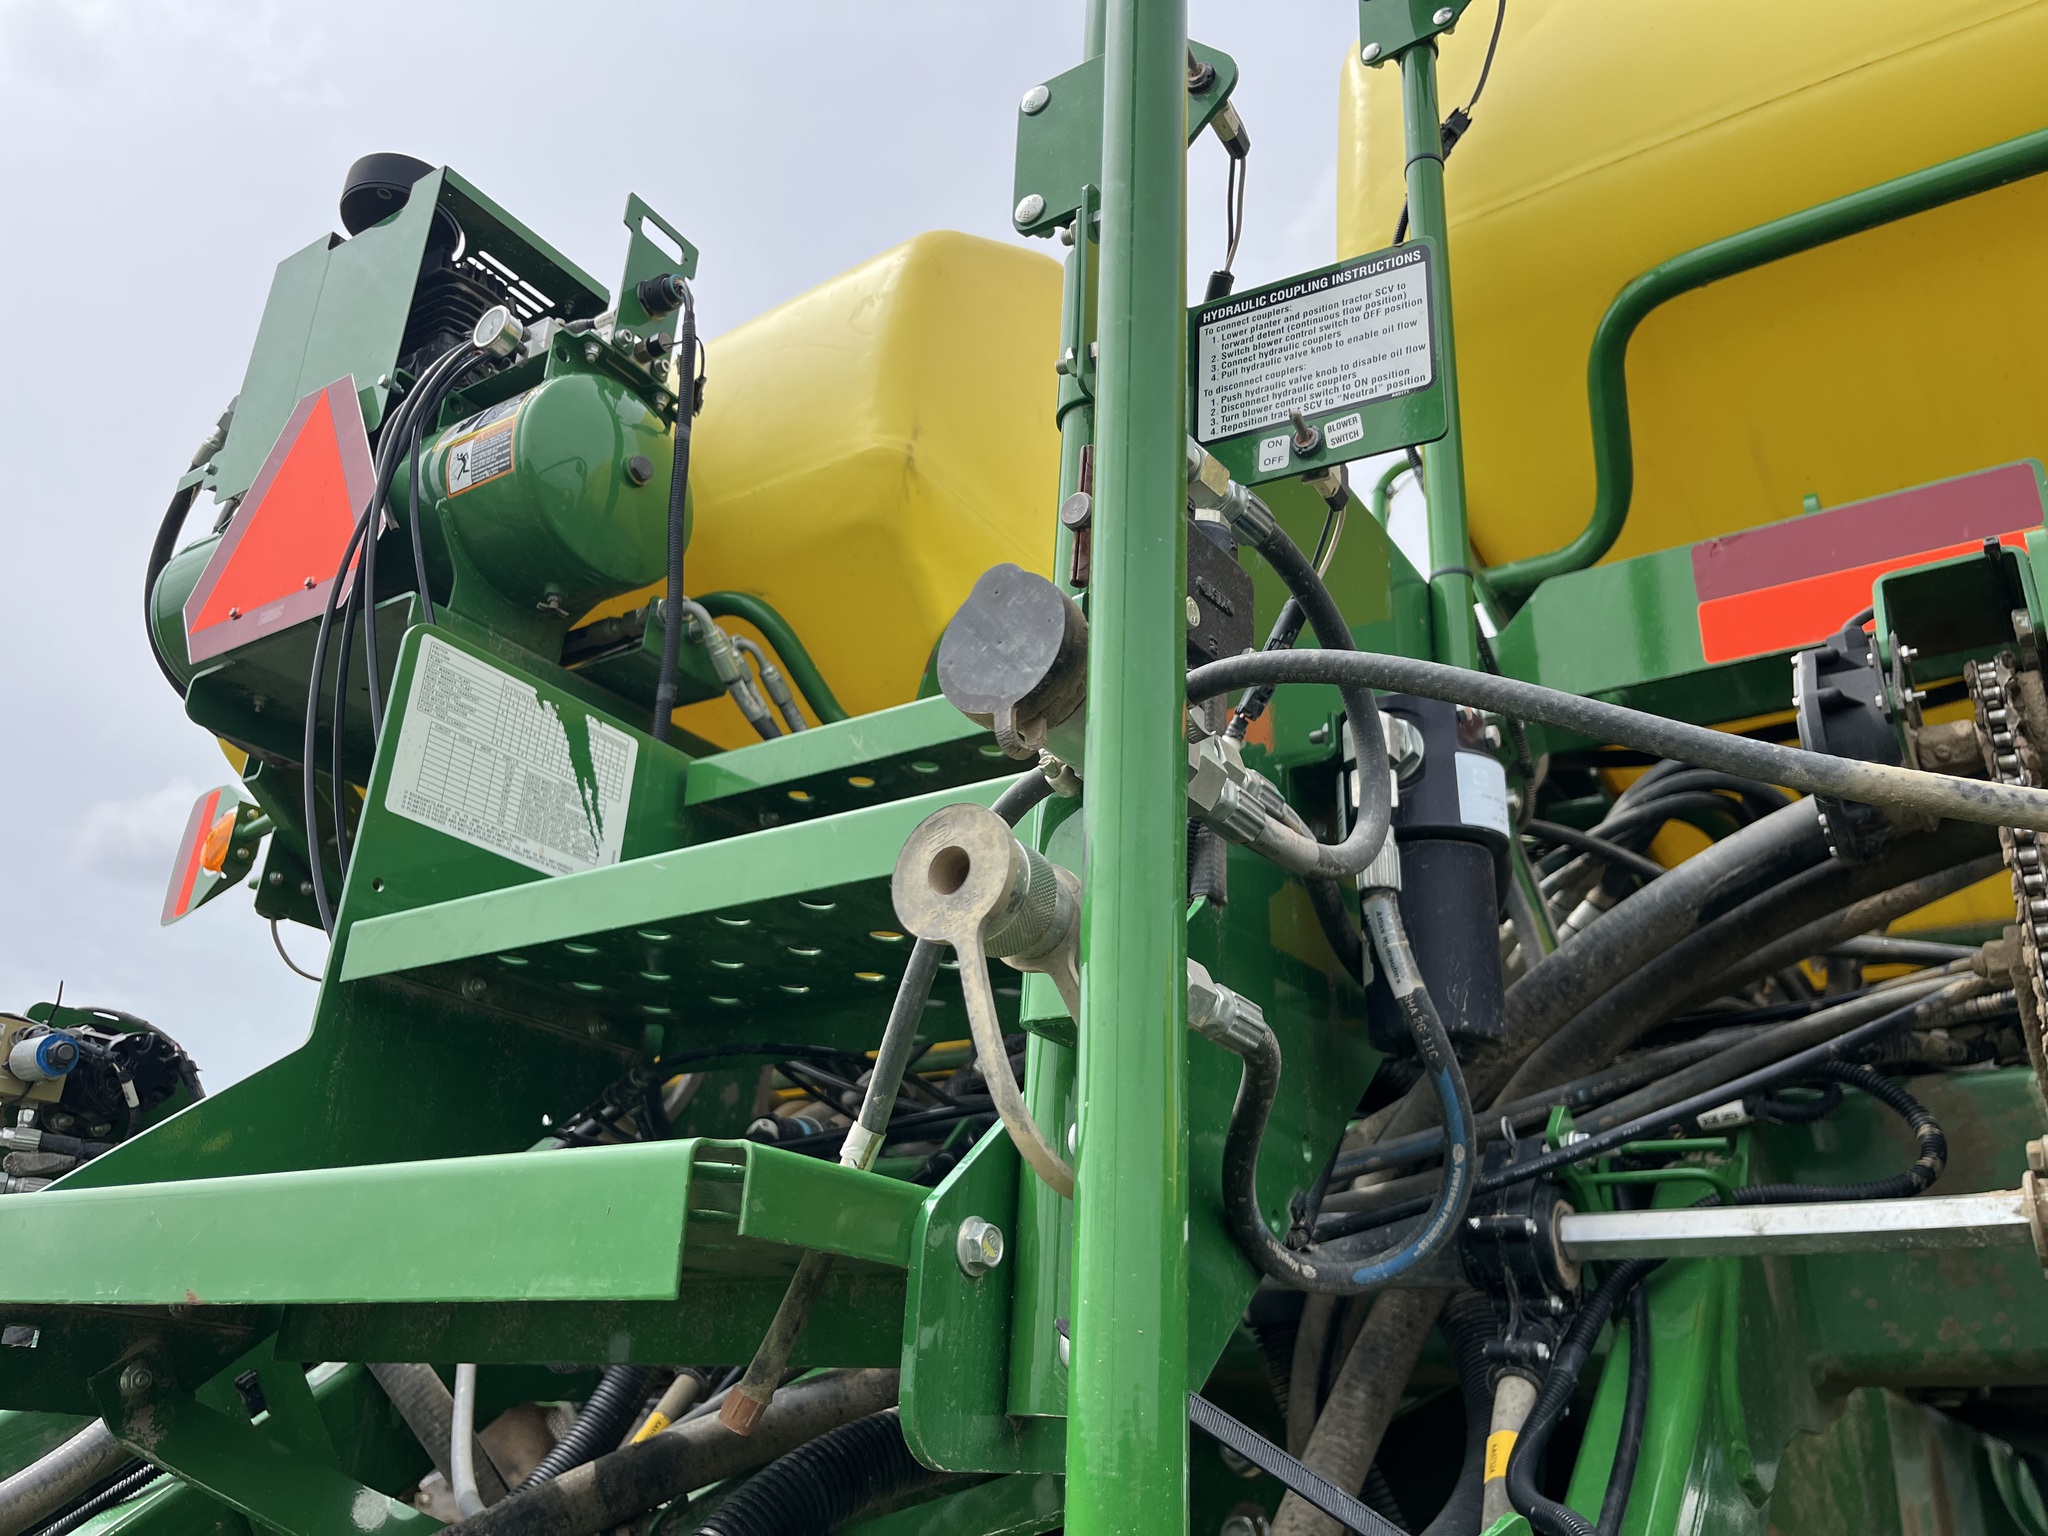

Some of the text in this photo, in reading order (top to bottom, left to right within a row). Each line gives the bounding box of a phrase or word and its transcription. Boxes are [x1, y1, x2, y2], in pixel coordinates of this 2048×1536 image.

[1203, 250, 1422, 324] HYDRAULIC COUPLING INSTRUCTIONS
[1211, 282, 1406, 344] 1. Lower planter and position tractor SCV to
[1203, 305, 1292, 337] To connect couplers:
[1210, 297, 1423, 364] 2. Switch blower control switch to OFF position
[1221, 290, 1407, 351] forward detent (continuous flow position)
[1210, 319, 1418, 382] 4. Pull hydraulic valve knob to enable oil flow
[1210, 330, 1342, 373] 3. Connect hydraulic couplers
[1210, 343, 1426, 407] 1. Push hydraulic valve knob to disable oil flow
[1202, 364, 1307, 398] To disconnect couplers:
[1210, 371, 1357, 417] 2. Disconnect hydraulic couplers
[1210, 368, 1410, 427] 3. Turn blower control switch to ON position
[1210, 427, 1219, 436] 4.
[1220, 415, 1268, 434] Reposition
[1302, 398, 1323, 412] SCV
[1324, 397, 1334, 406] to
[1386, 374, 1426, 392] position
[1267, 439, 1283, 449] ON
[1327, 416, 1358, 434] BLOWER
[1330, 430, 1359, 446] SWITCH
[1263, 456, 1284, 466] OFF
